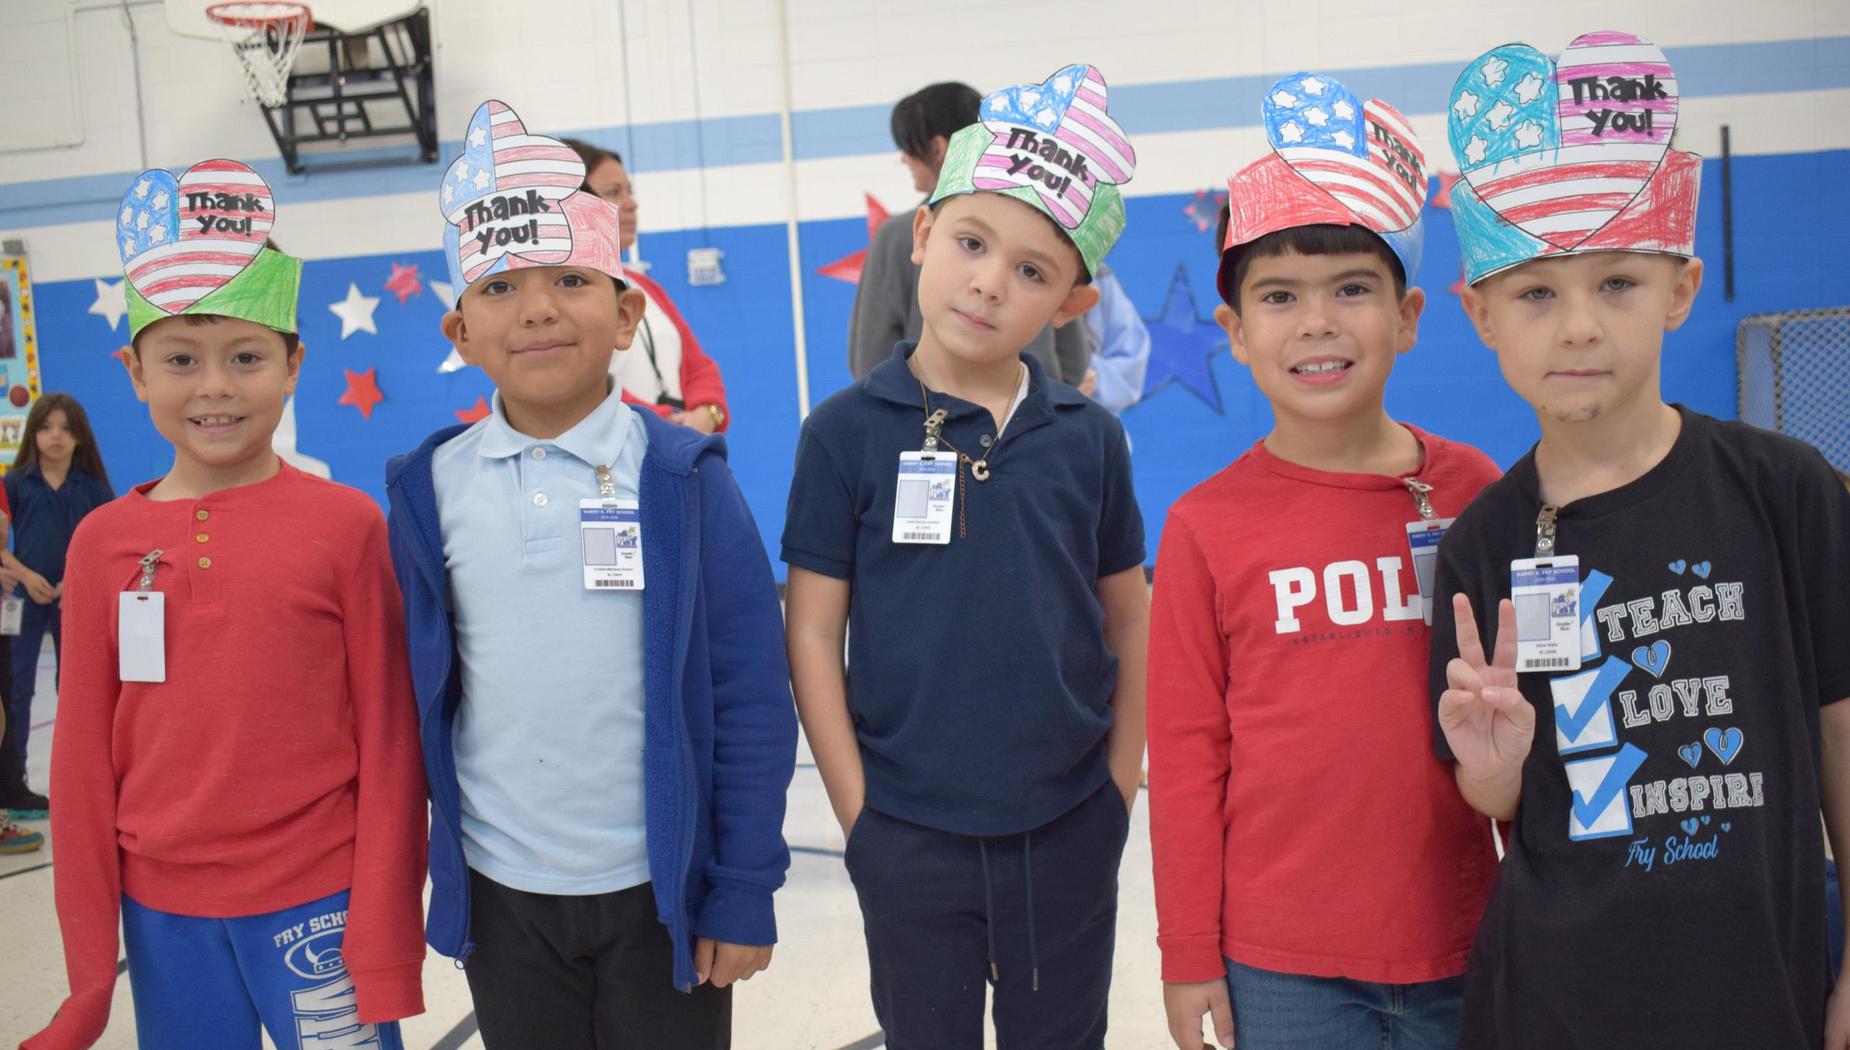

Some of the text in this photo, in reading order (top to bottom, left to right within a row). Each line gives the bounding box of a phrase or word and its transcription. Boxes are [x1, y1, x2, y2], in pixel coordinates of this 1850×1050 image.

[1567, 74, 1668, 106] Thank
[1006, 127, 1089, 182] Thank
[1370, 121, 1423, 177] Thank
[185, 191, 265, 213] Thank
[464, 189, 551, 233] Thank
[1597, 581, 1745, 643] TEACH
[1618, 675, 1733, 729] LOVE
[1624, 834, 1719, 872] Fry School
[272, 922, 305, 948] FRY
